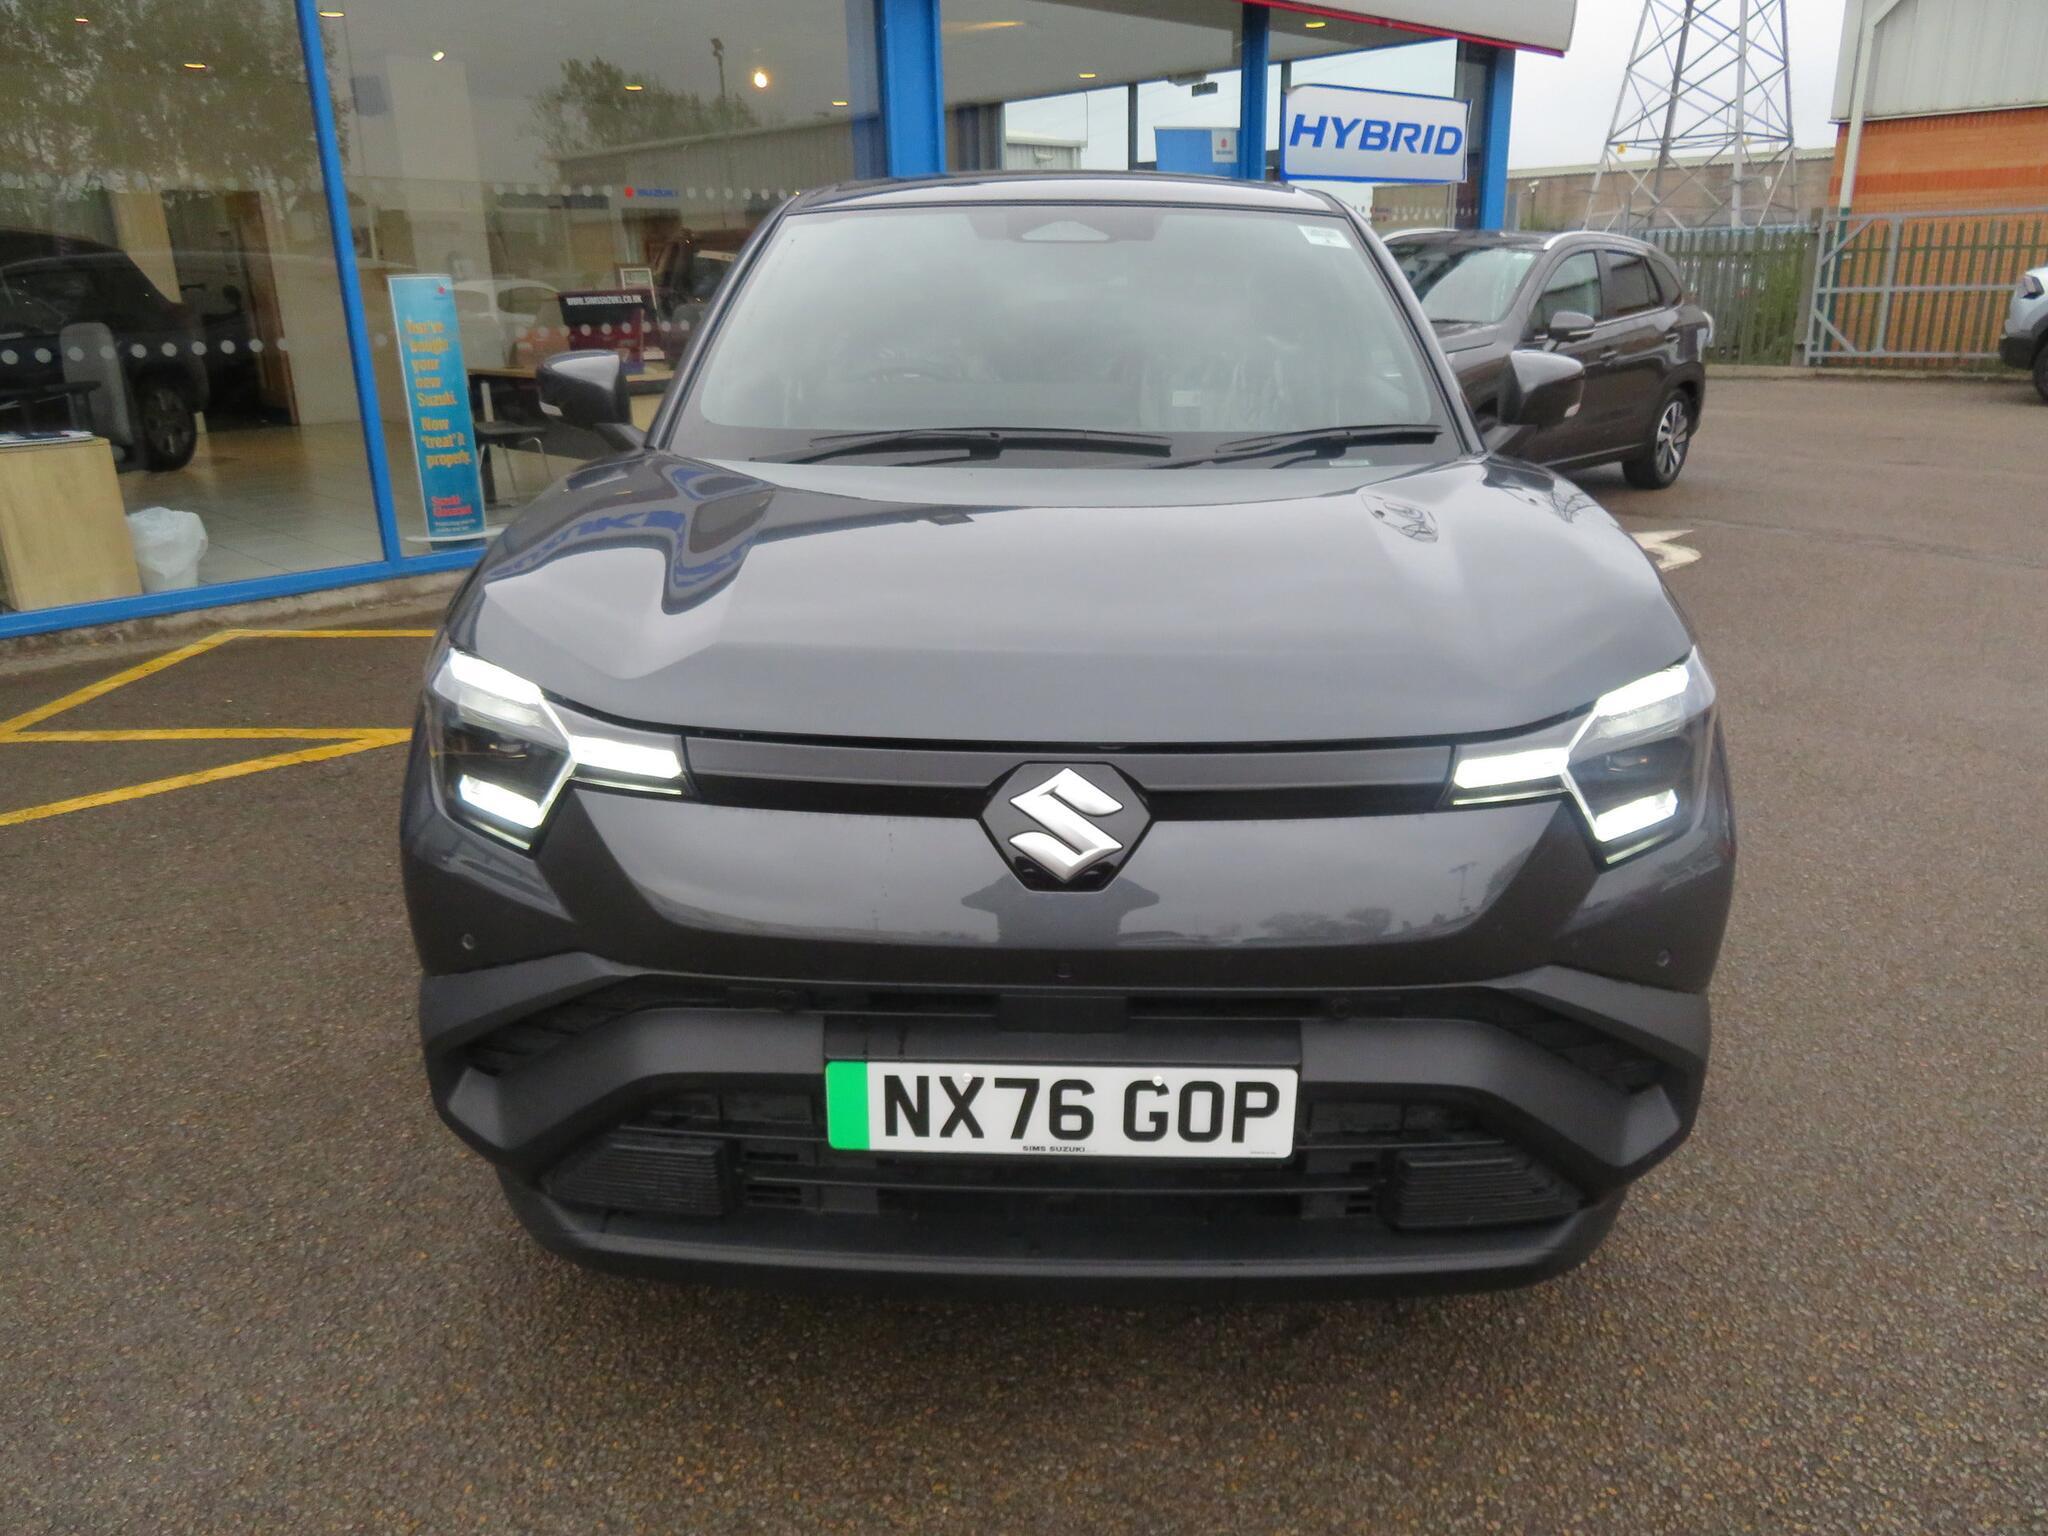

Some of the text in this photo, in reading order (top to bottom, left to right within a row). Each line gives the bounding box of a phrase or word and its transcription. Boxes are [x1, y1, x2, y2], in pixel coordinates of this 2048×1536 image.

[1289, 113, 1463, 155] HYBRID
[884, 1075, 1280, 1143] NX76 GOP
